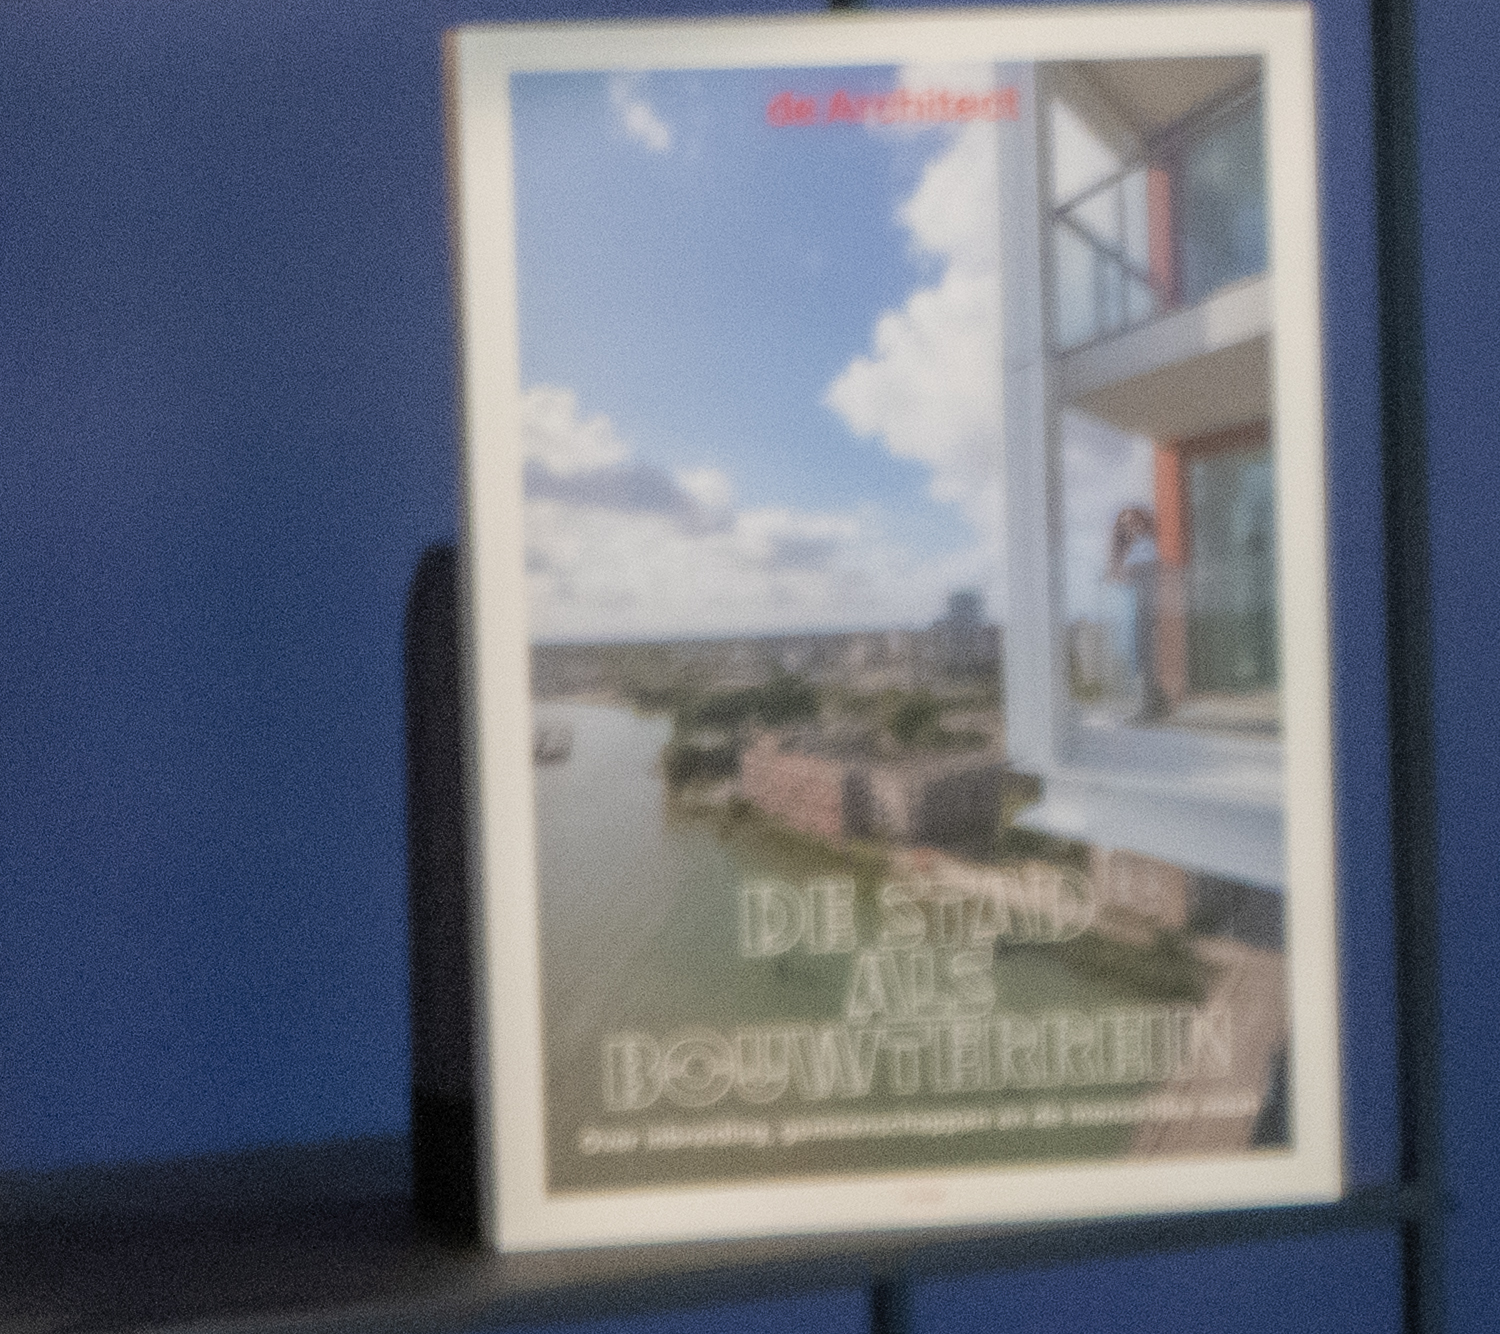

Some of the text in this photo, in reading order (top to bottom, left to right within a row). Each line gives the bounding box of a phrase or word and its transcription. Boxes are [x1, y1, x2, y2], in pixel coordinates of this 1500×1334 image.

[766, 86, 1018, 127] de Architect
[737, 859, 1095, 957] DE STAD
[847, 941, 995, 1021] ALS
[603, 1005, 1232, 1112] BOUWTERREIN
